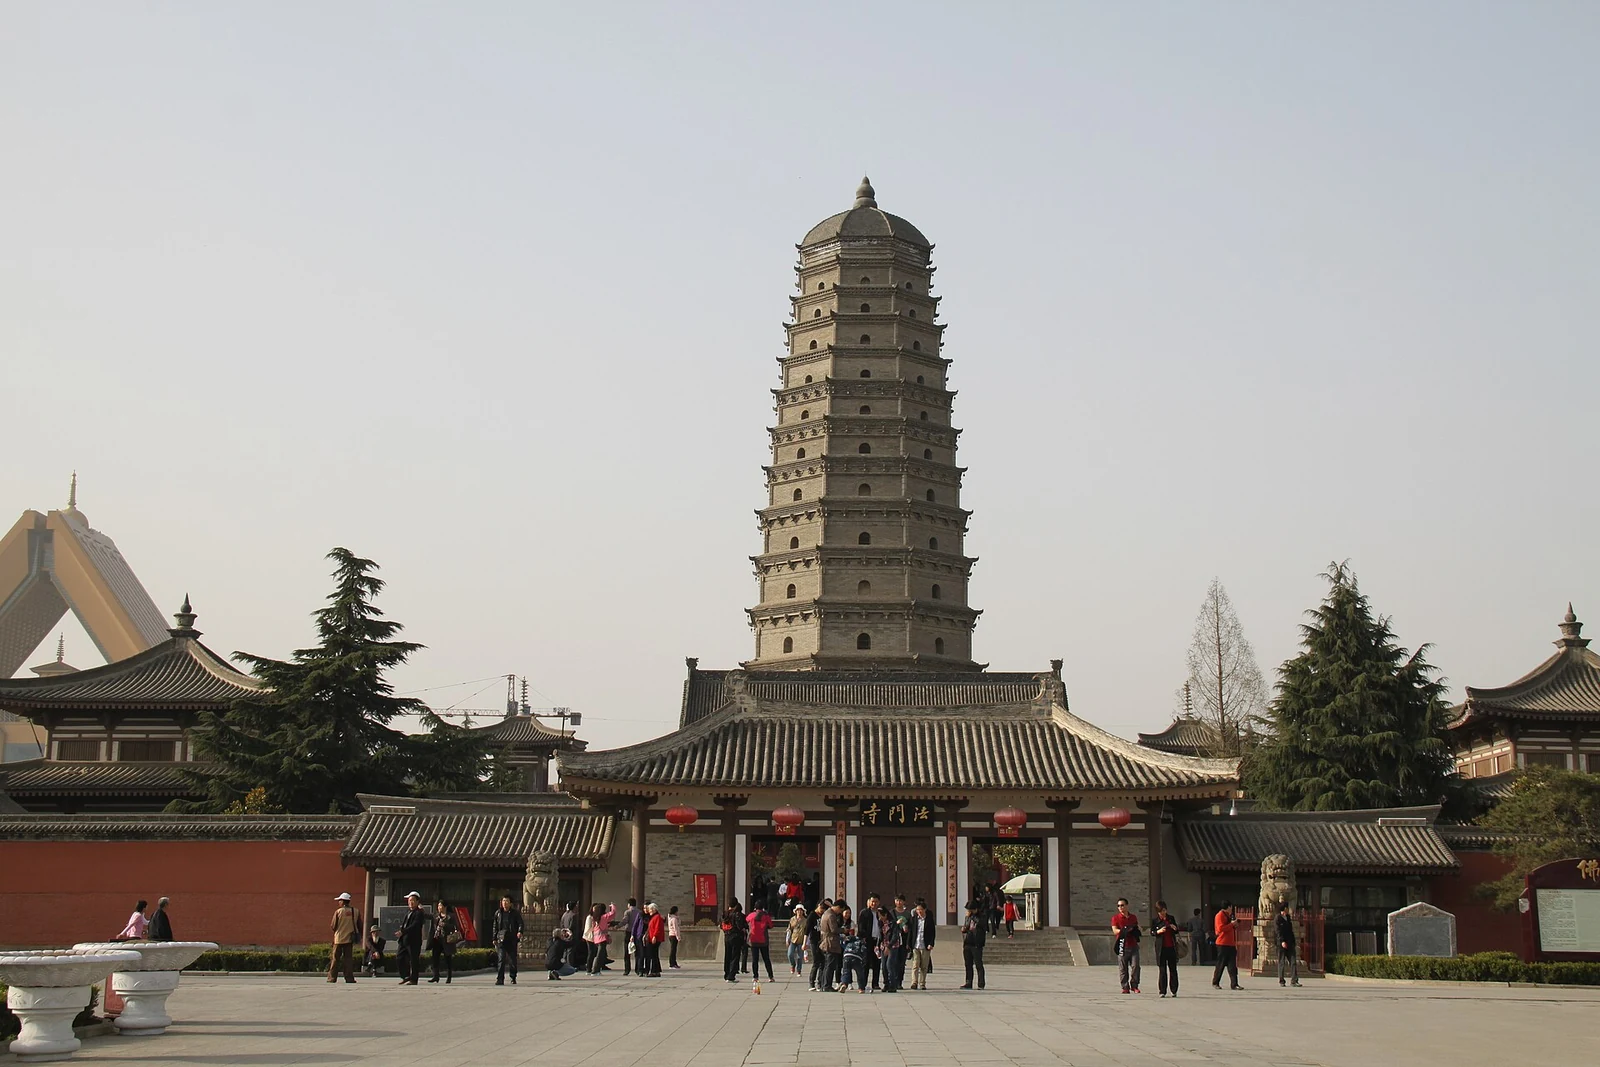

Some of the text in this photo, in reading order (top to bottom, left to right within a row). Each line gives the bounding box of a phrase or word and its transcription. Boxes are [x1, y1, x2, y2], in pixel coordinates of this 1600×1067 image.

[863, 802, 930, 824] 法門寺
[1577, 859, 1600, 882] 佛
